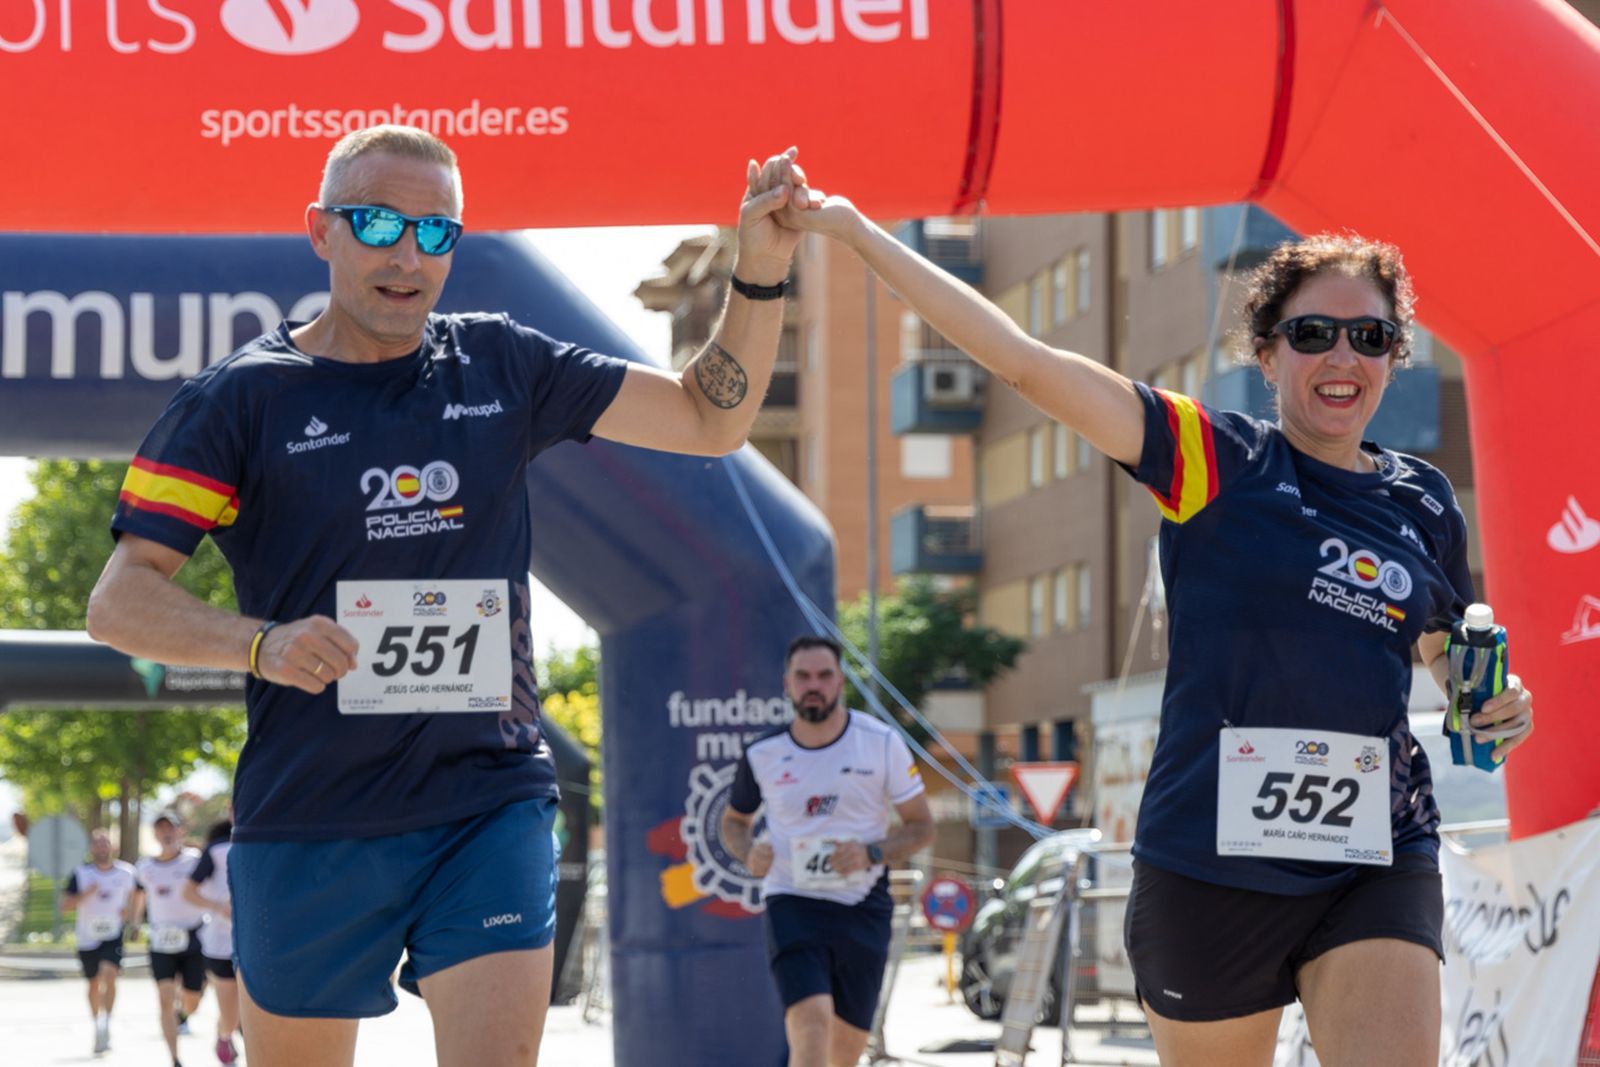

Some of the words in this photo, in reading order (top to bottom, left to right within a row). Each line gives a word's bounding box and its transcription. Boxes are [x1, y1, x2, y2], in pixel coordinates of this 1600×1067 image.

[382, 0, 930, 51] Santander
[201, 99, 569, 146] sportssantander.es
[286, 432, 350, 454] Santander
[360, 460, 460, 511] 200
[366, 508, 442, 529] POLICIA
[367, 518, 464, 541] NACIONAL
[1317, 537, 1413, 602] 200
[343, 609, 384, 618] Santander
[1308, 589, 1398, 633] NACIONAL
[1312, 577, 1388, 614] POLICIA
[371, 624, 481, 677] 551
[384, 684, 408, 695] JESÚS
[410, 683, 431, 695] CAÑO
[431, 683, 474, 695] HERNÁNDEZ
[667, 690, 795, 728] fundaci
[1252, 772, 1360, 828] 552
[1263, 828, 1286, 838] MARÍA
[1287, 830, 1307, 841] CAÑO
[1307, 832, 1349, 845] HERNÁNDEZ
[805, 853, 833, 875] 46
[483, 913, 522, 928] LIXADA
